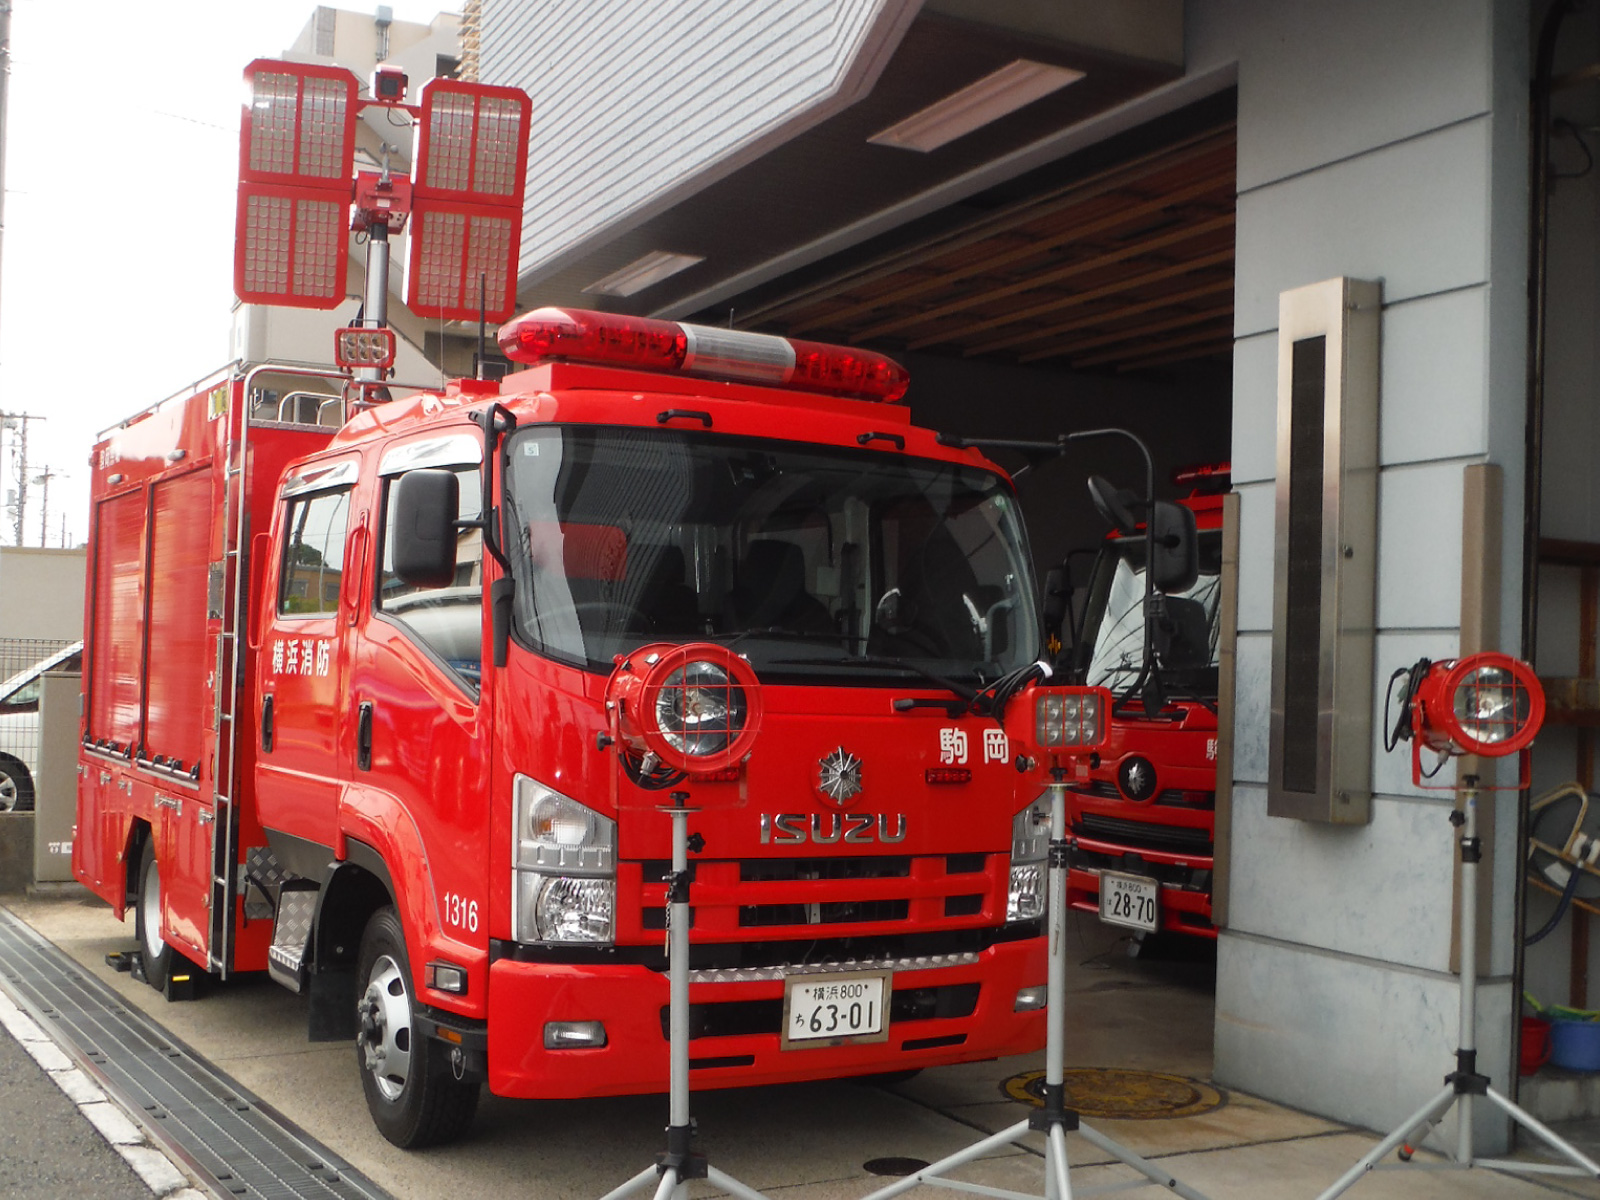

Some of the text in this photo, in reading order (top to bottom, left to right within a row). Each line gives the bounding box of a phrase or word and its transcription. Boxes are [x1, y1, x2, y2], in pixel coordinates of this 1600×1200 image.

[272, 639, 330, 676] 横浜消防
[940, 727, 1009, 764] 駒岡
[760, 813, 906, 844] ISUZU
[444, 891, 478, 933] 1316
